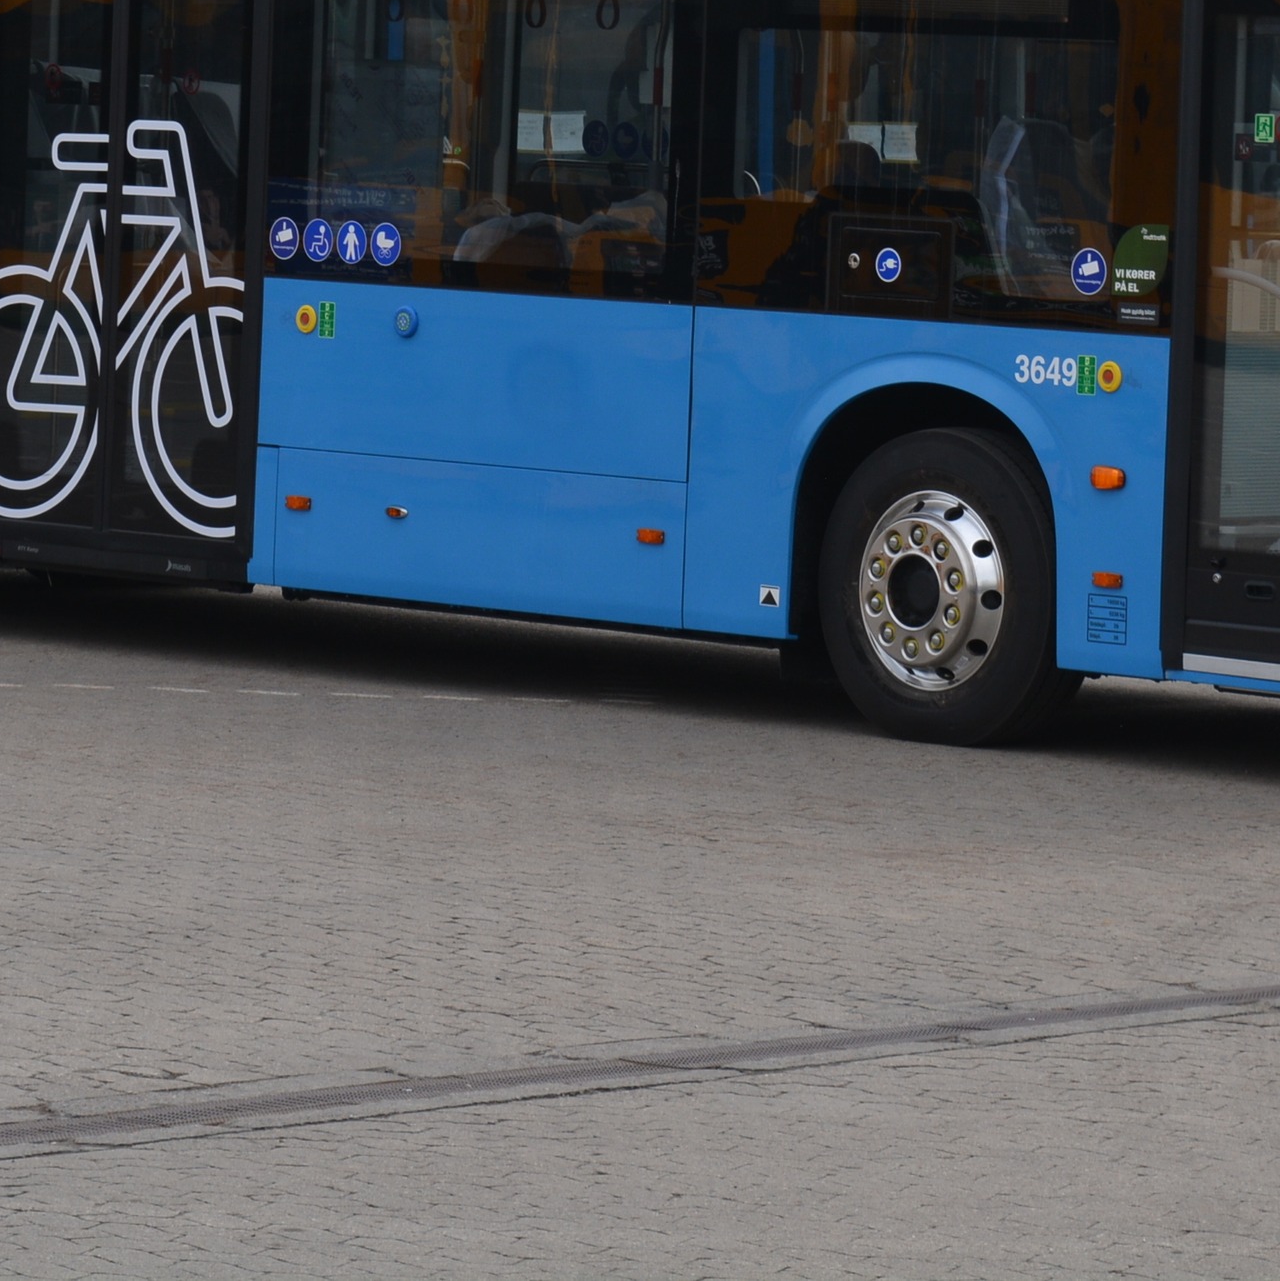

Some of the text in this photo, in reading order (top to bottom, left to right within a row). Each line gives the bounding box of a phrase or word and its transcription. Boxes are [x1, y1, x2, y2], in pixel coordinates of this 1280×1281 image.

[1114, 268, 1124, 278] VI
[1114, 279, 1127, 292] PÅ
[1128, 282, 1140, 293] EL
[1014, 354, 1077, 386] 3649
